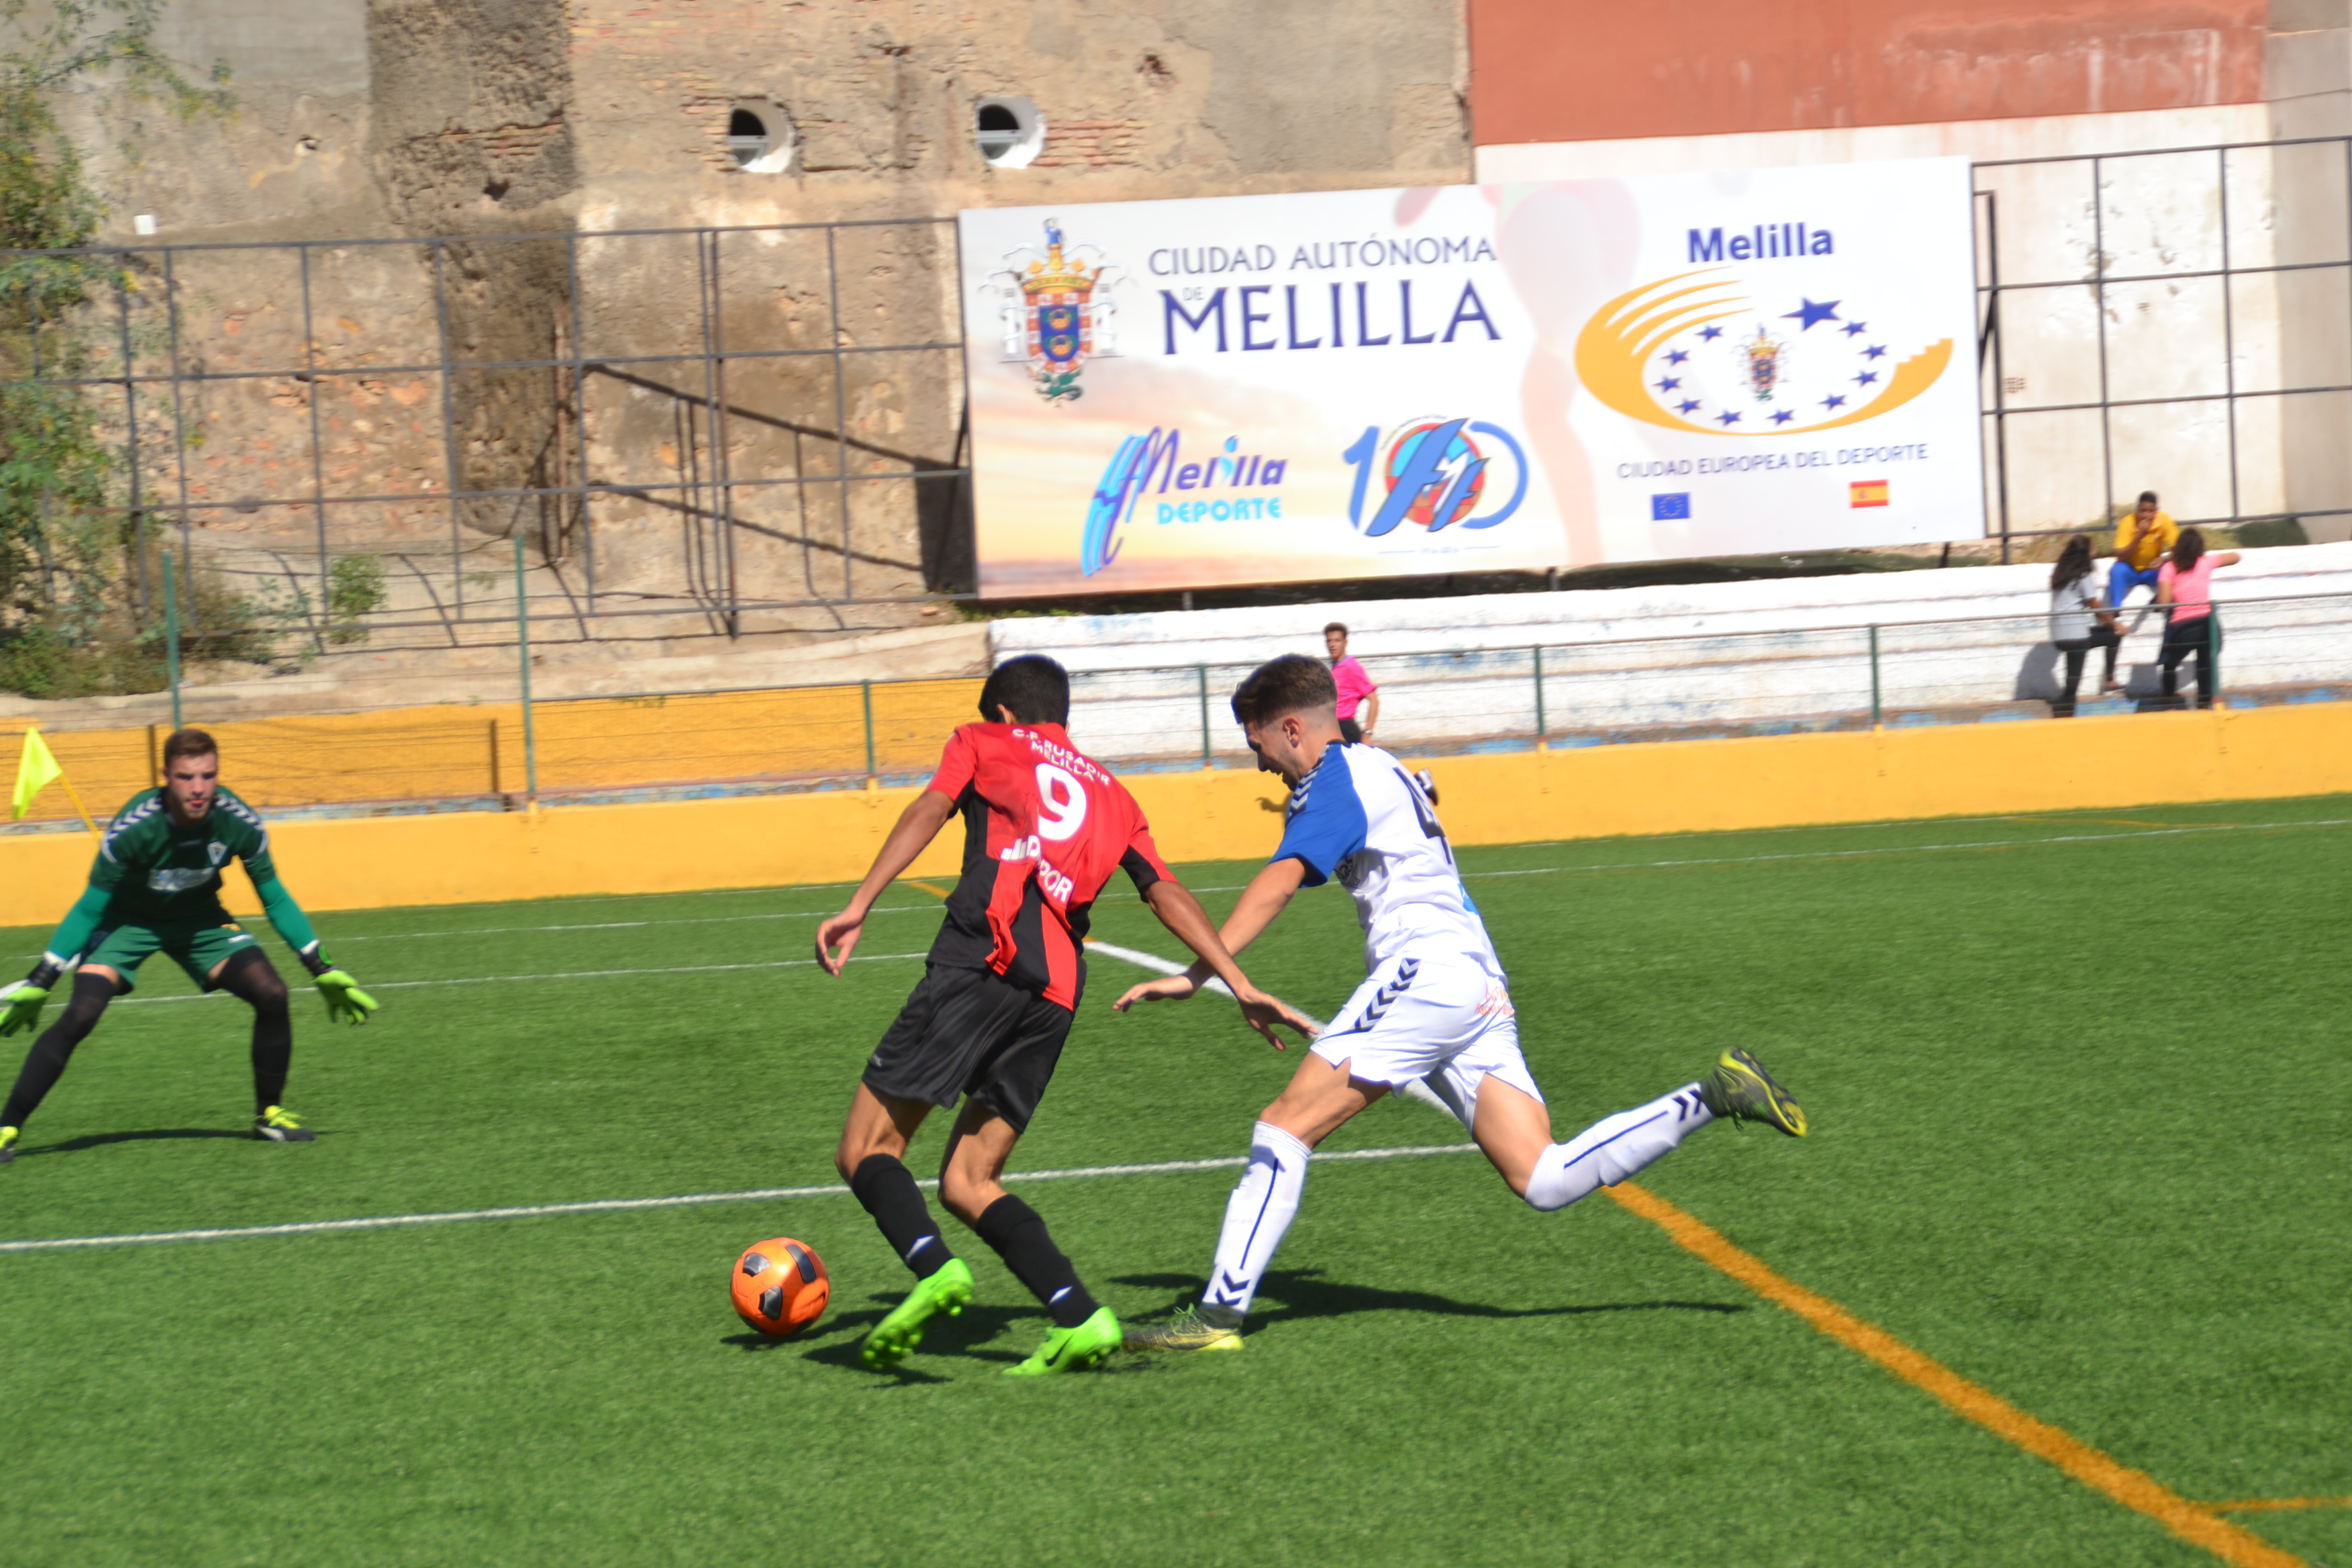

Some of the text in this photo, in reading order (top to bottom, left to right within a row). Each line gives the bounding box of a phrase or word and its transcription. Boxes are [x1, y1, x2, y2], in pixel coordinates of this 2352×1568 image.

[1149, 232, 1499, 276] CIUDAD AUTÓNOMA
[1687, 222, 1835, 263] Melilla
[1183, 287, 1204, 301] DE
[1156, 278, 1504, 355] MELILLA
[1130, 426, 1288, 494] Melilla
[1617, 443, 1930, 478] CIUDAD EUROPEA DEL DEPORTE
[1157, 497, 1282, 525] DEPORTE
[1031, 740, 1094, 782] MELILLA
[1044, 738, 1109, 785] RUSADIR
[1035, 762, 1087, 840] 9
